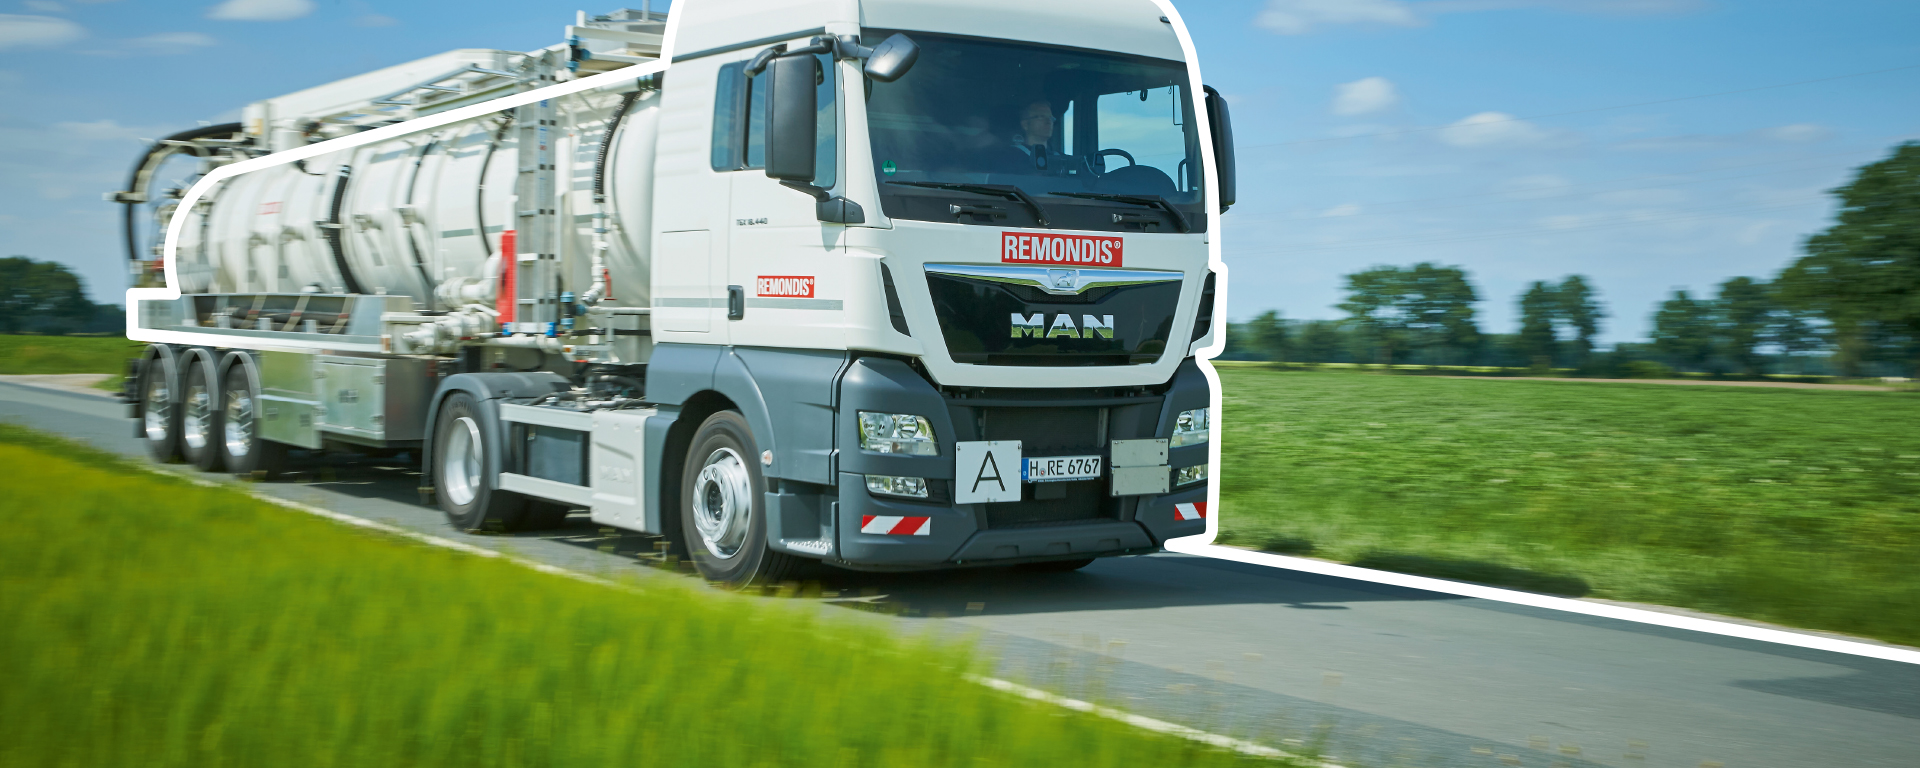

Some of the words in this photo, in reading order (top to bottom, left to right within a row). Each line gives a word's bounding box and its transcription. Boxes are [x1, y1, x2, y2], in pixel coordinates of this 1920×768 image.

[1010, 312, 1114, 339] MAN
[971, 450, 1006, 493] A
[1029, 460, 1039, 477] H
[1047, 459, 1065, 476] RE
[1067, 458, 1100, 475] 6767
